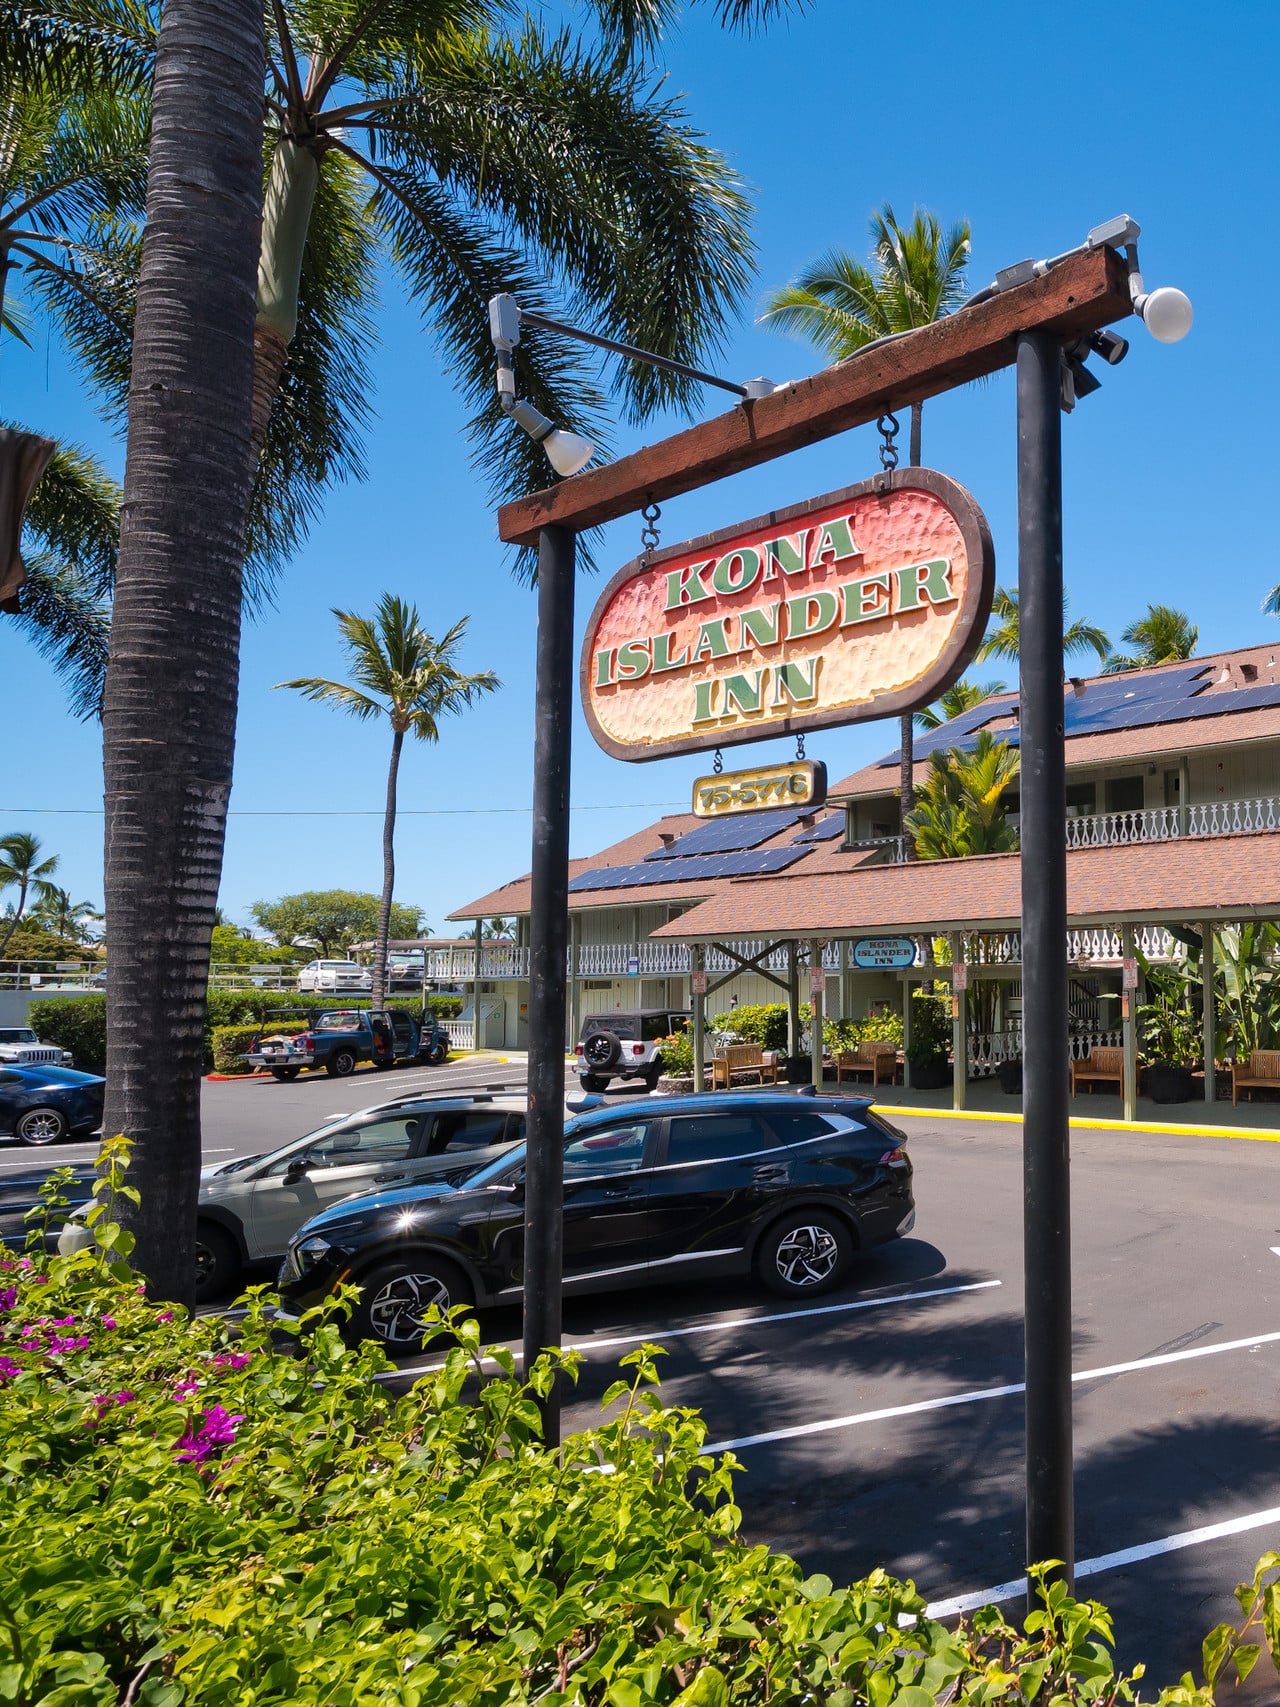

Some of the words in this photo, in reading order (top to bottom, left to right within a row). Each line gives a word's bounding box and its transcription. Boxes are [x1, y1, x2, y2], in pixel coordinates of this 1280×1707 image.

[663, 513, 865, 613] KONA
[595, 557, 959, 688] ISLANDER
[691, 655, 823, 726] INN
[700, 773, 807, 808] 75-5776
